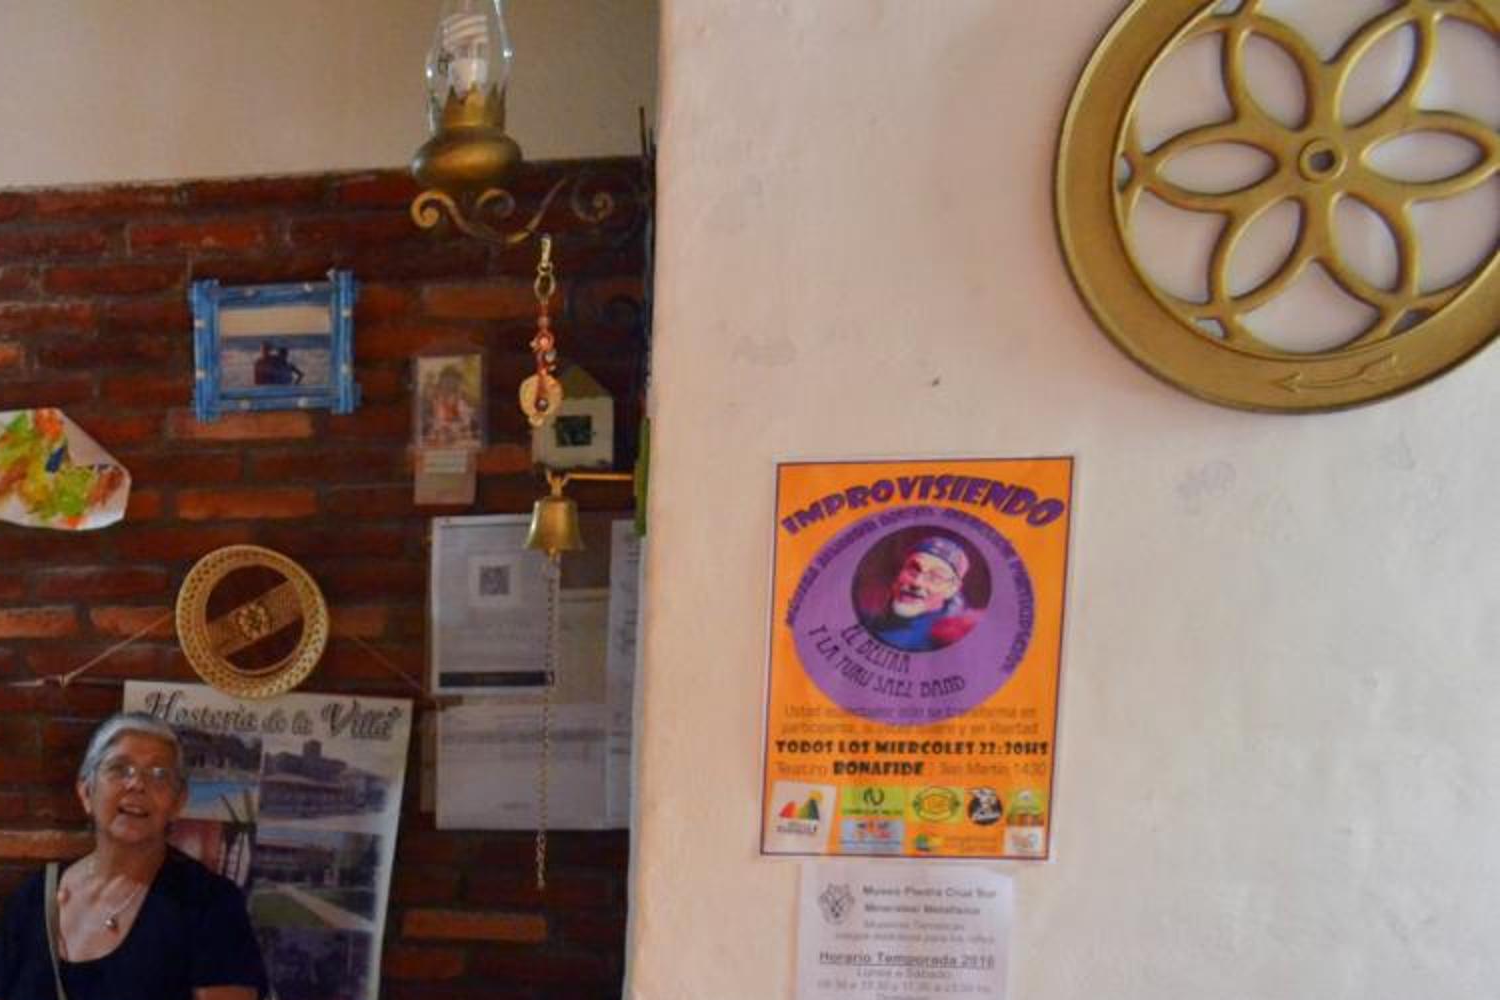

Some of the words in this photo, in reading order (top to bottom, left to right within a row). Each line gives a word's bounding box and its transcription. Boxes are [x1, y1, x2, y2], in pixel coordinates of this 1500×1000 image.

[781, 474, 1066, 535] IMPROVISIENDO
[775, 740, 833, 753] TODOS
[837, 740, 869, 754] LOS
[875, 740, 975, 755] MIERCOLES
[833, 761, 924, 776] BONAFIDE
[819, 951, 871, 963] Horario
